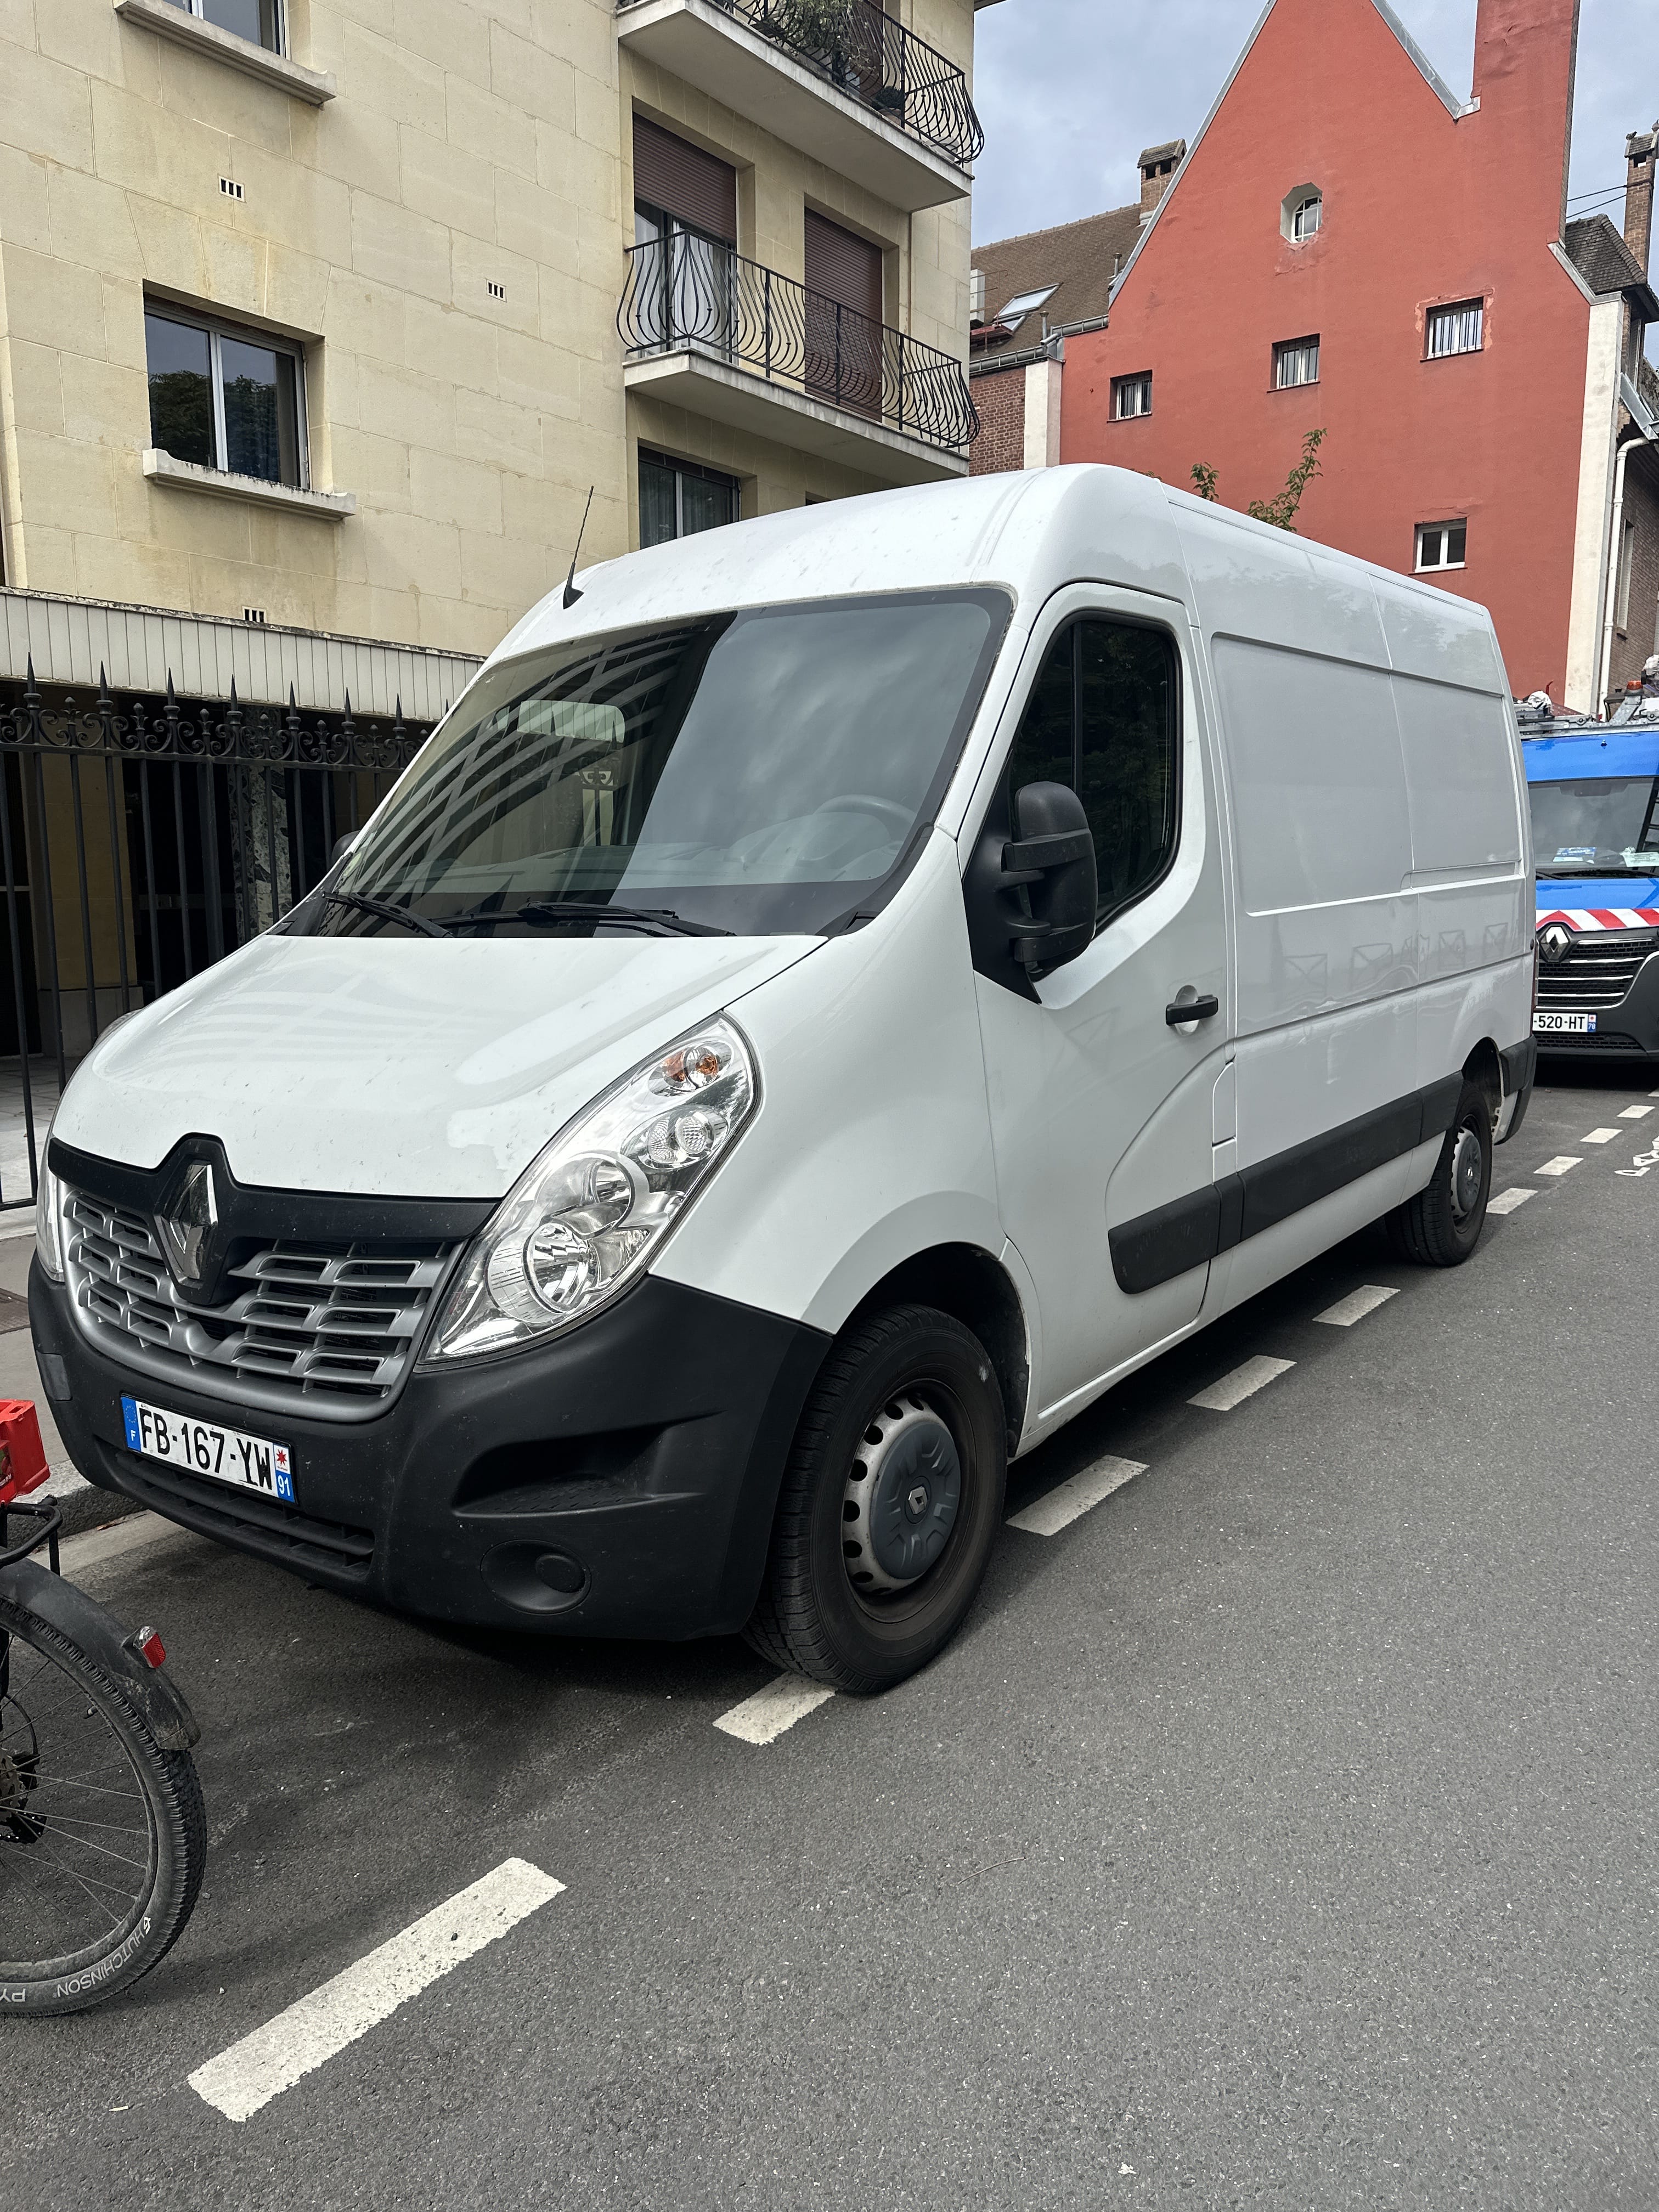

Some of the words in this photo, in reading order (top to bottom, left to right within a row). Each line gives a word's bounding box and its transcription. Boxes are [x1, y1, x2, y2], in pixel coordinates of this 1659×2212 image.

[131, 1430, 136, 1441] F
[139, 1408, 272, 1490] FB-167-YW
[278, 1475, 291, 1497] 91
[57, 1926, 145, 1997] HUTCHINSON
